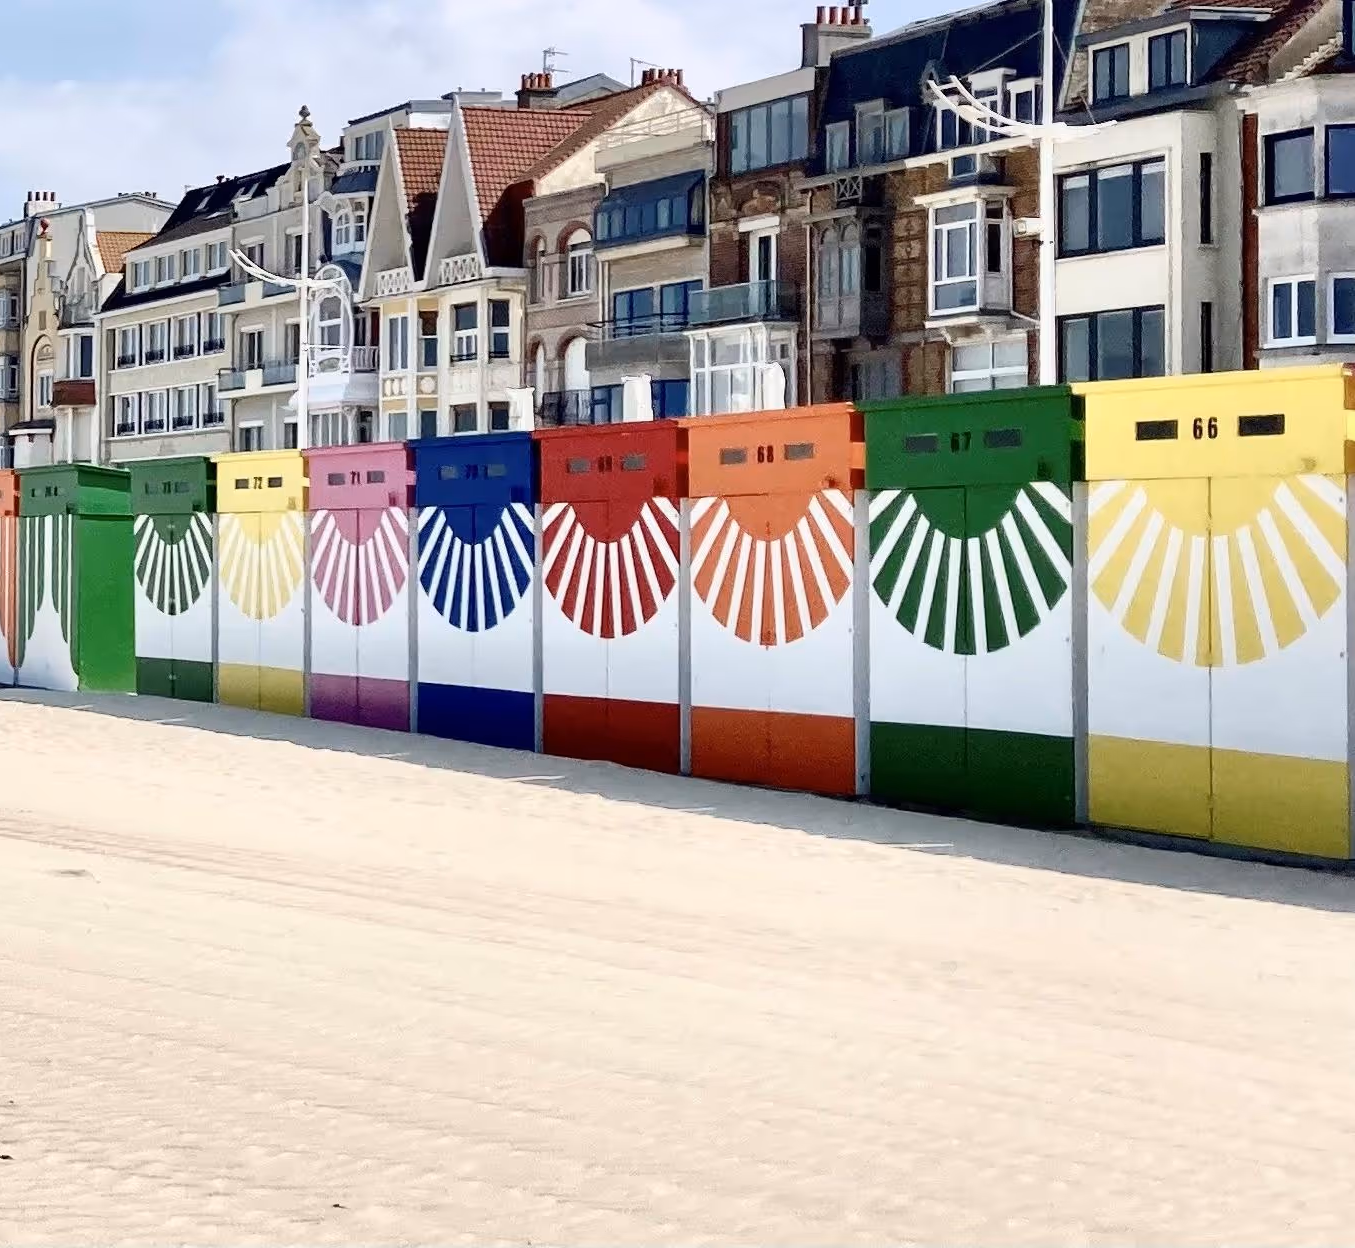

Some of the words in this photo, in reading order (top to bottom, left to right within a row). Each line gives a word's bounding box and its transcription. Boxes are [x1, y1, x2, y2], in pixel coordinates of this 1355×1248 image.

[1193, 417, 1218, 440] 66
[951, 431, 971, 452] 67
[757, 445, 774, 463] 68
[253, 476, 263, 490] 72
